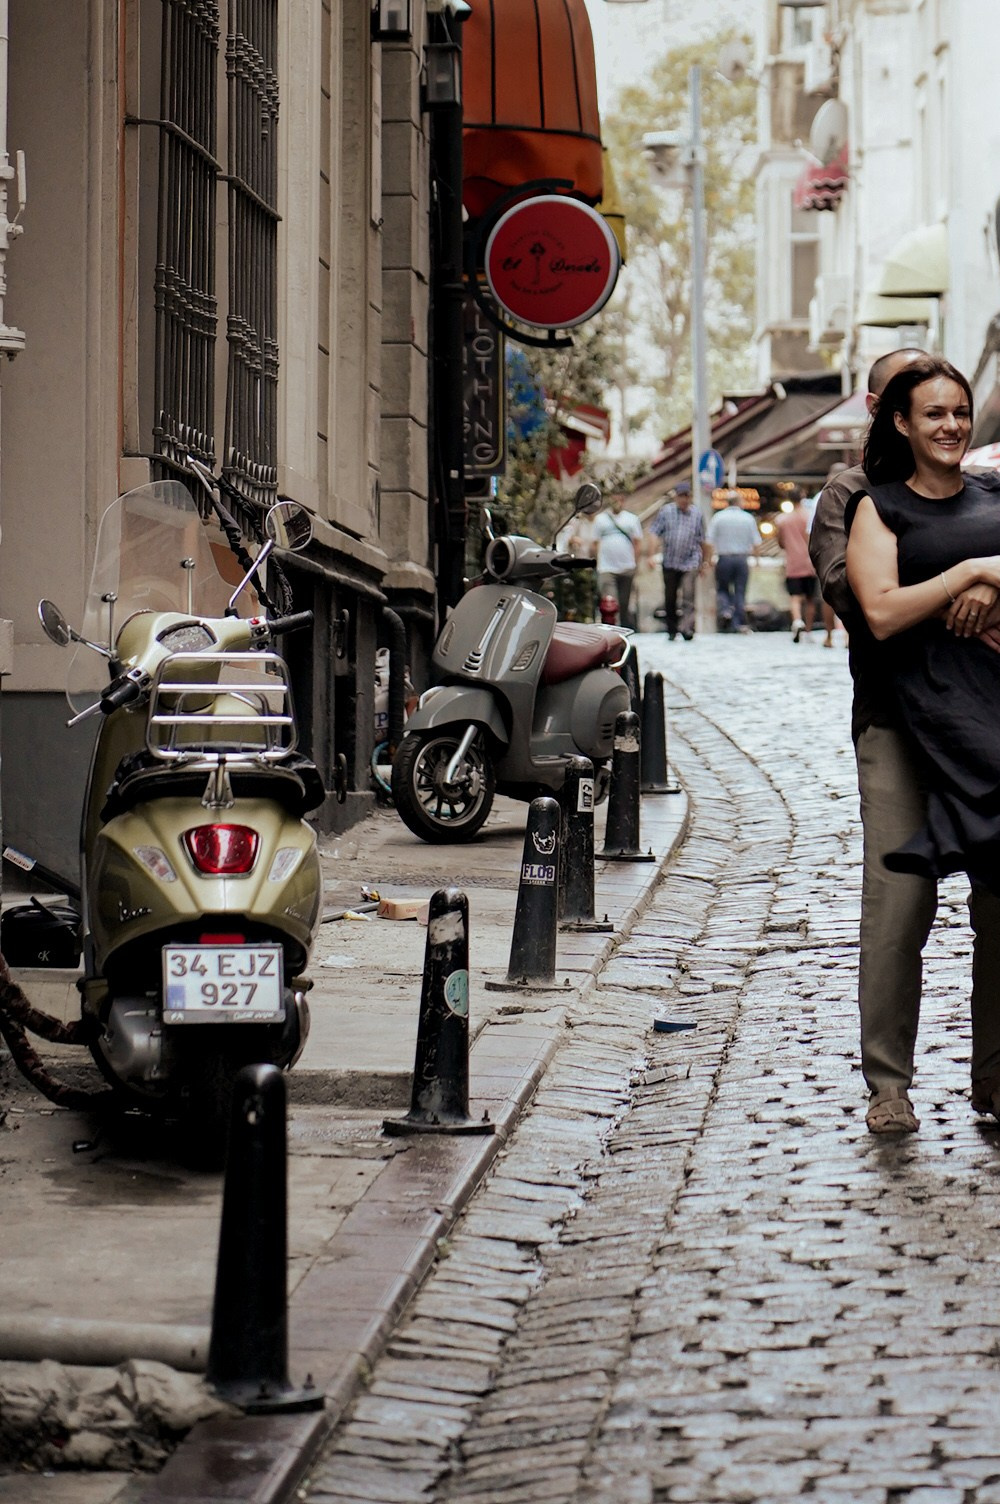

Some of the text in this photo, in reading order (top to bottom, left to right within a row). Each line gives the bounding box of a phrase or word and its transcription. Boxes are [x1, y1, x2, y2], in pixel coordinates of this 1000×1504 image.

[170, 954, 276, 977] 34 EJZ
[201, 983, 258, 1006] 927
